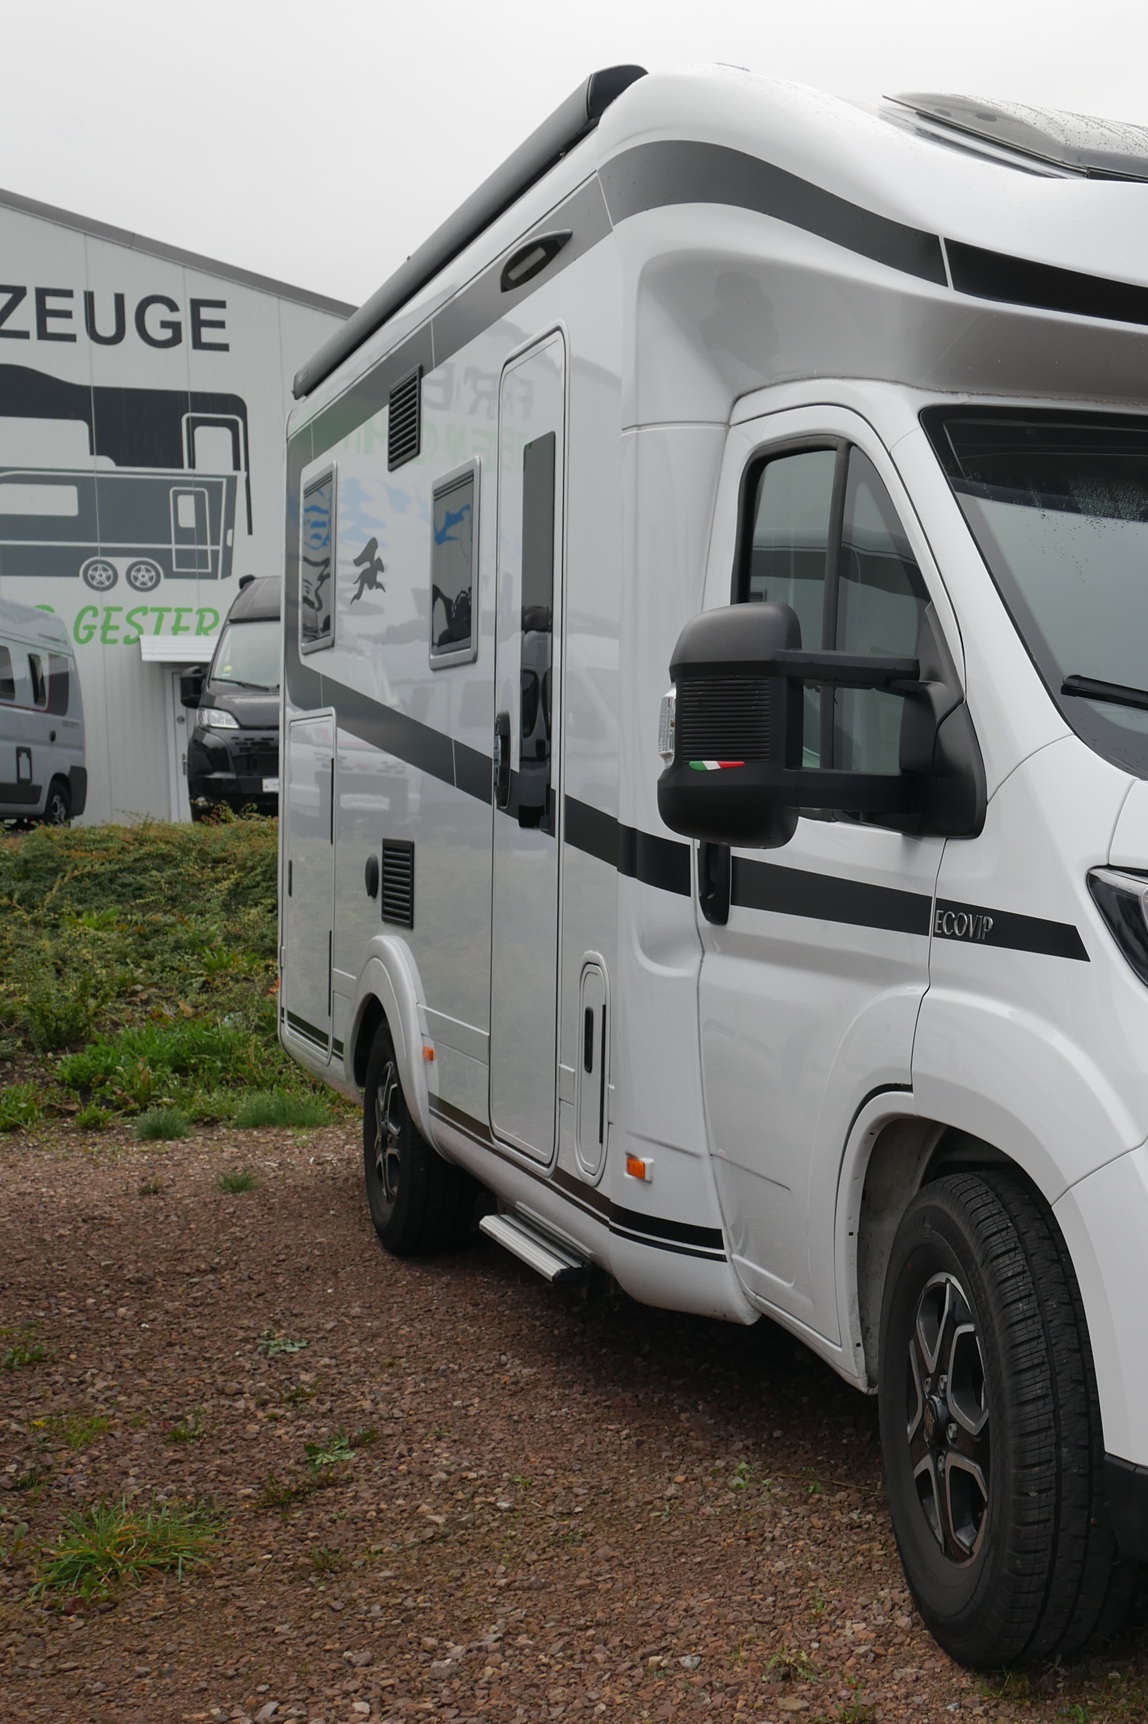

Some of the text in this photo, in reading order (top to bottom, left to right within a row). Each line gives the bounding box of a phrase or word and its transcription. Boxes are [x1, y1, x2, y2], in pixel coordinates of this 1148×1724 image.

[0, 284, 230, 352] ZEUGE
[73, 604, 229, 645] GESTER
[934, 909, 994, 940] ECOVIP
